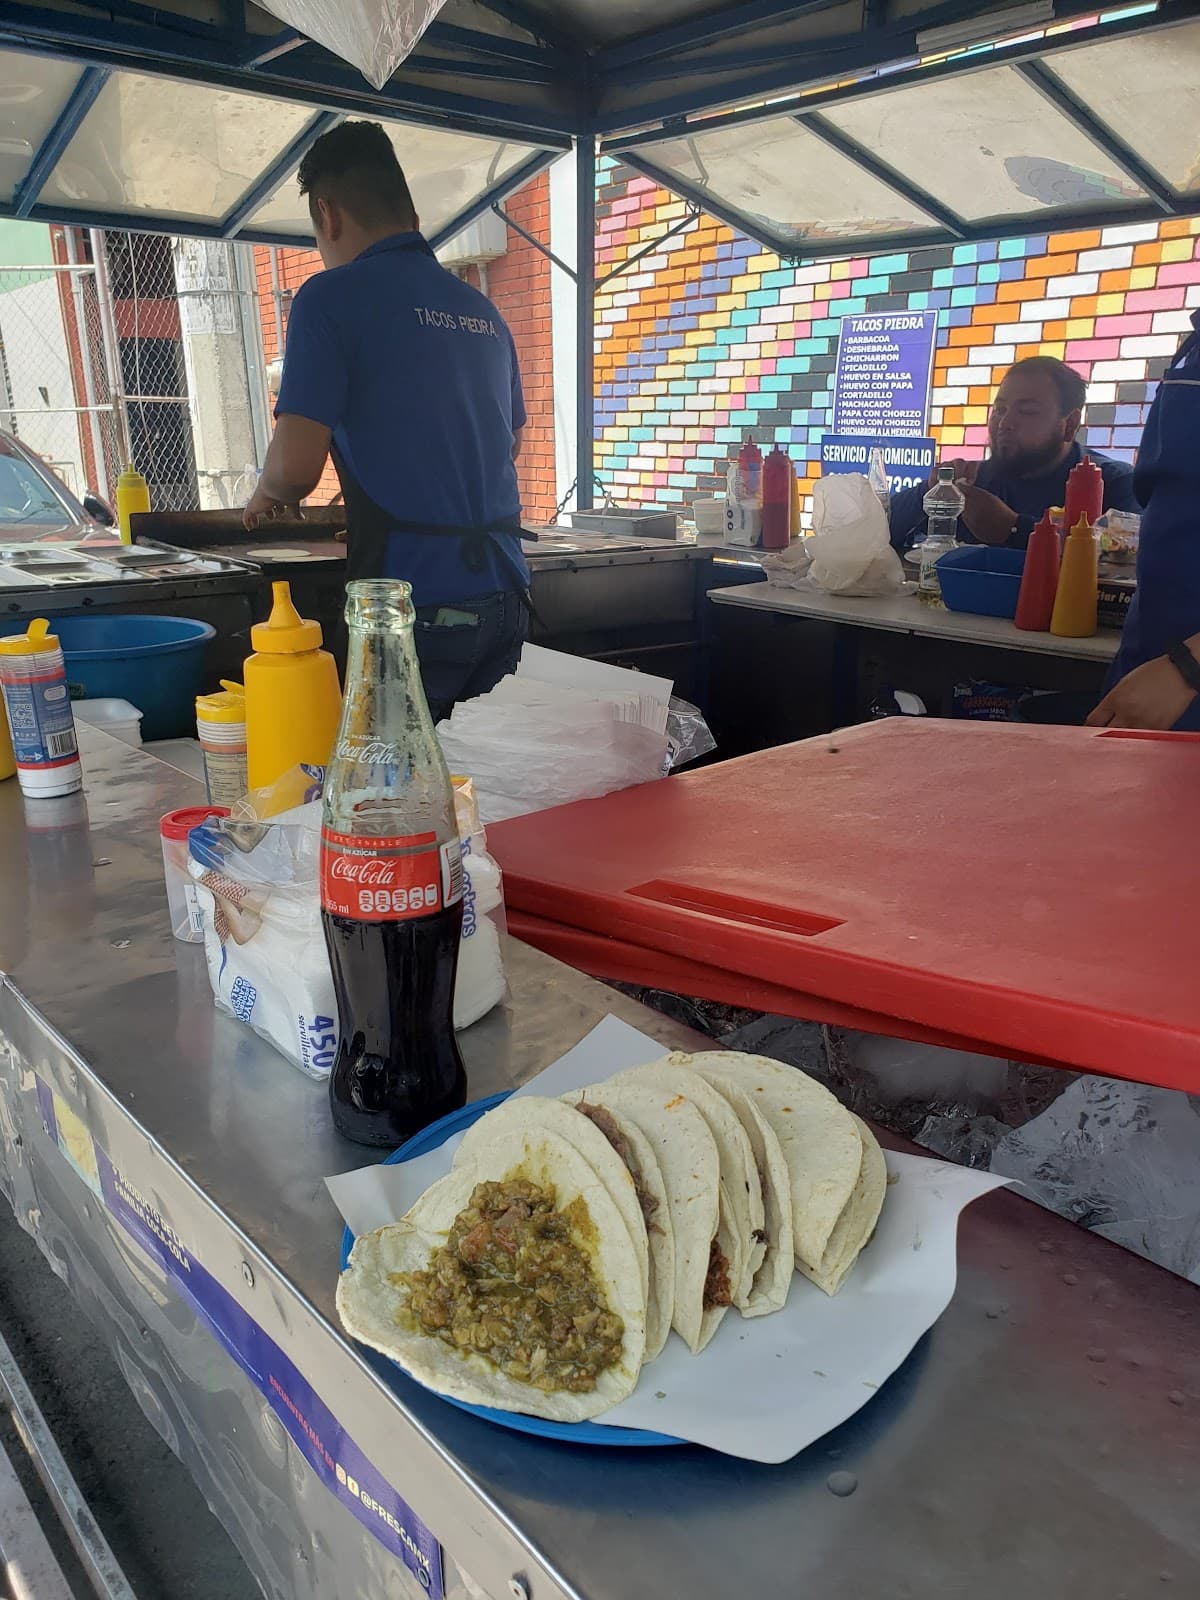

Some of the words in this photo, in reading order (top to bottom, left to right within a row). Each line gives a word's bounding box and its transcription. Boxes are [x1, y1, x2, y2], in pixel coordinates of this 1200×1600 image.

[414, 307, 457, 330] TACOS
[459, 315, 497, 337] PIEDRA
[851, 319, 883, 332] TACOS
[884, 317, 924, 330] PIEDRA
[848, 335, 890, 344] BARBACOA
[846, 344, 900, 353] DESHEBRADA
[844, 363, 888, 372] PICADILLO
[843, 373, 871, 381] HUEVO
[884, 372, 912, 380] SALSA
[843, 382, 870, 390] HUEVO
[870, 382, 890, 390] CON
[890, 382, 913, 390] PAPA
[842, 391, 893, 399] CORTADILLO
[841, 400, 892, 408] MACHACADO
[841, 409, 862, 417] PAPA
[862, 409, 880, 417] CON
[881, 410, 922, 418] CHORIZO
[840, 418, 866, 426] HUEVO
[866, 418, 883, 426] CON
[884, 419, 921, 427] CHORIZO
[823, 444, 867, 463] SERVICIO
[882, 447, 932, 467] OMICILIO
[337, 740, 398, 765] Coca-Cola
[331, 856, 398, 885] Coca-Cola
[298, 1014, 311, 1069] servilletas
[308, 1015, 337, 1068] 450
[113, 1180, 147, 1222] FAMILIA
[360, 1490, 431, 1570] @FRESCAMX
